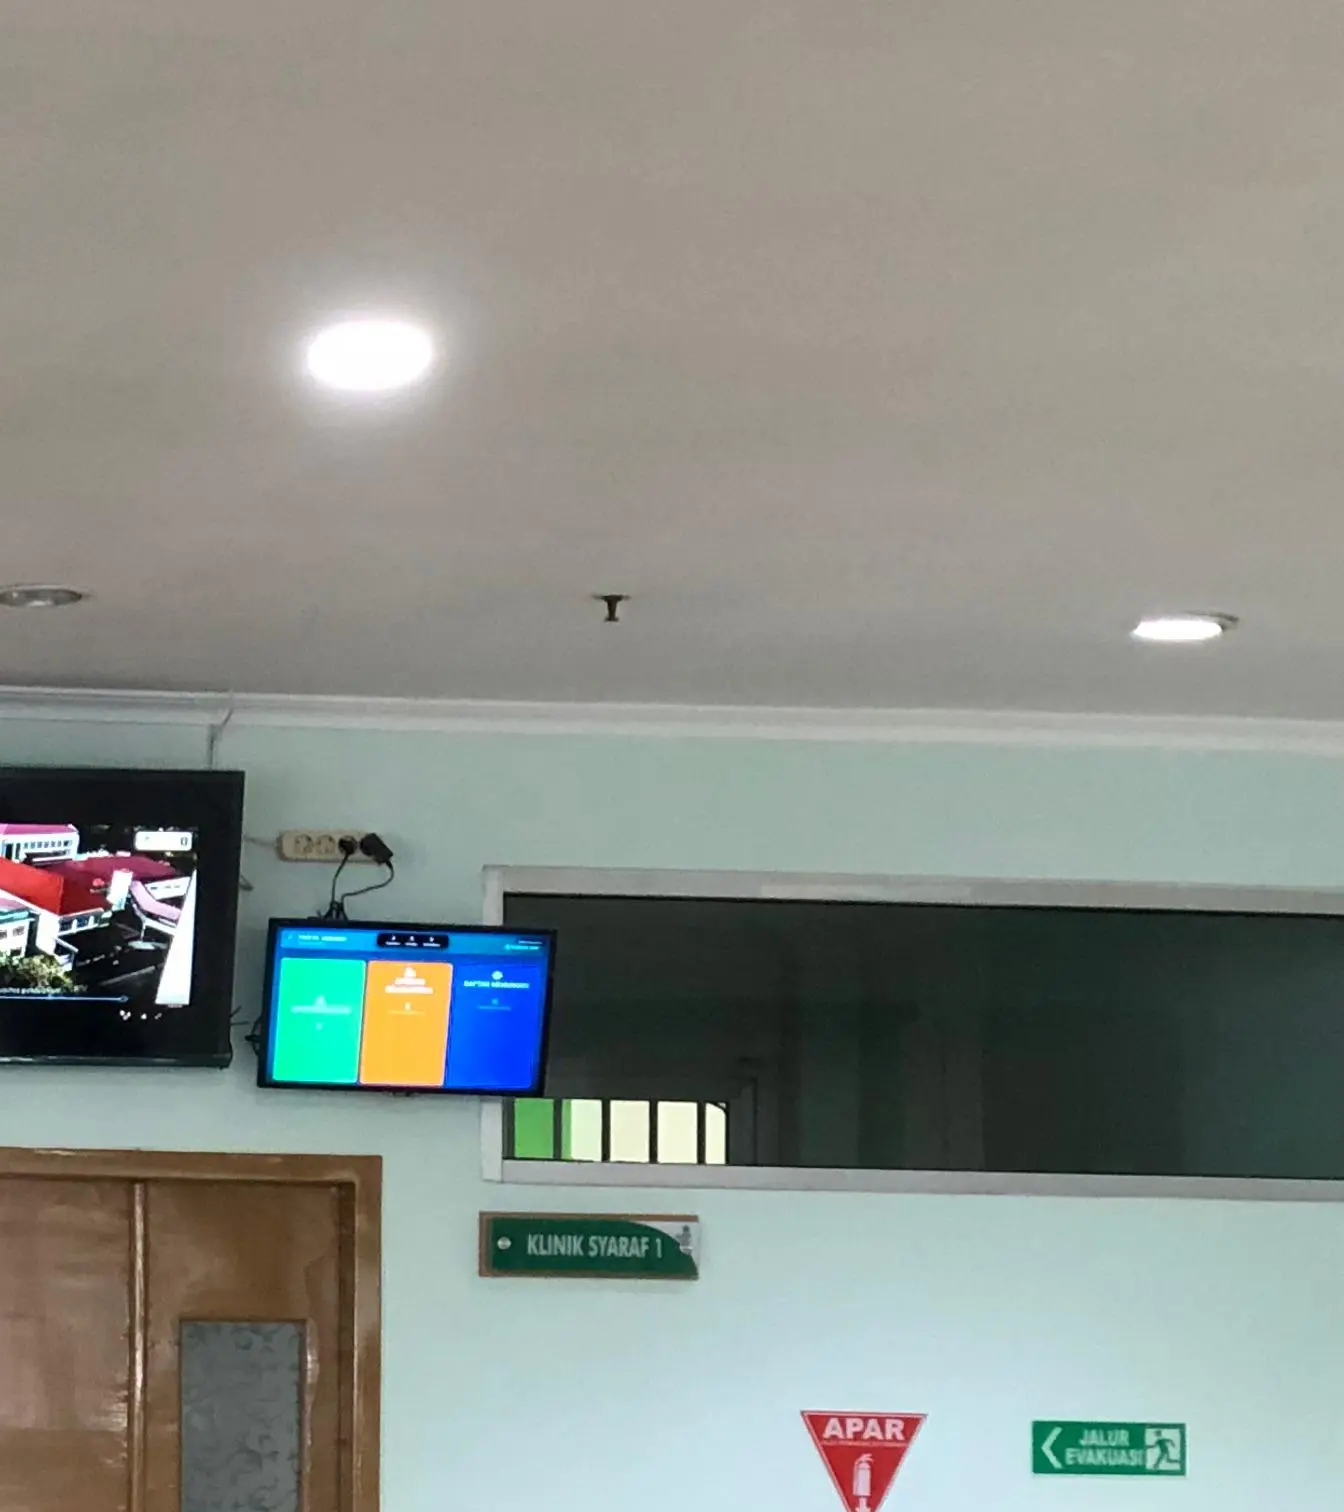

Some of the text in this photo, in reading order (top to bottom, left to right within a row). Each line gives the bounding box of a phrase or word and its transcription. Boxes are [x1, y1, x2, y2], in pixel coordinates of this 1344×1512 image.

[527, 1233, 663, 1258] KLINIK SYARAF 1
[823, 1417, 905, 1441] APAR
[1078, 1428, 1130, 1447] JALUR
[1065, 1447, 1145, 1467] EVAKUASI
